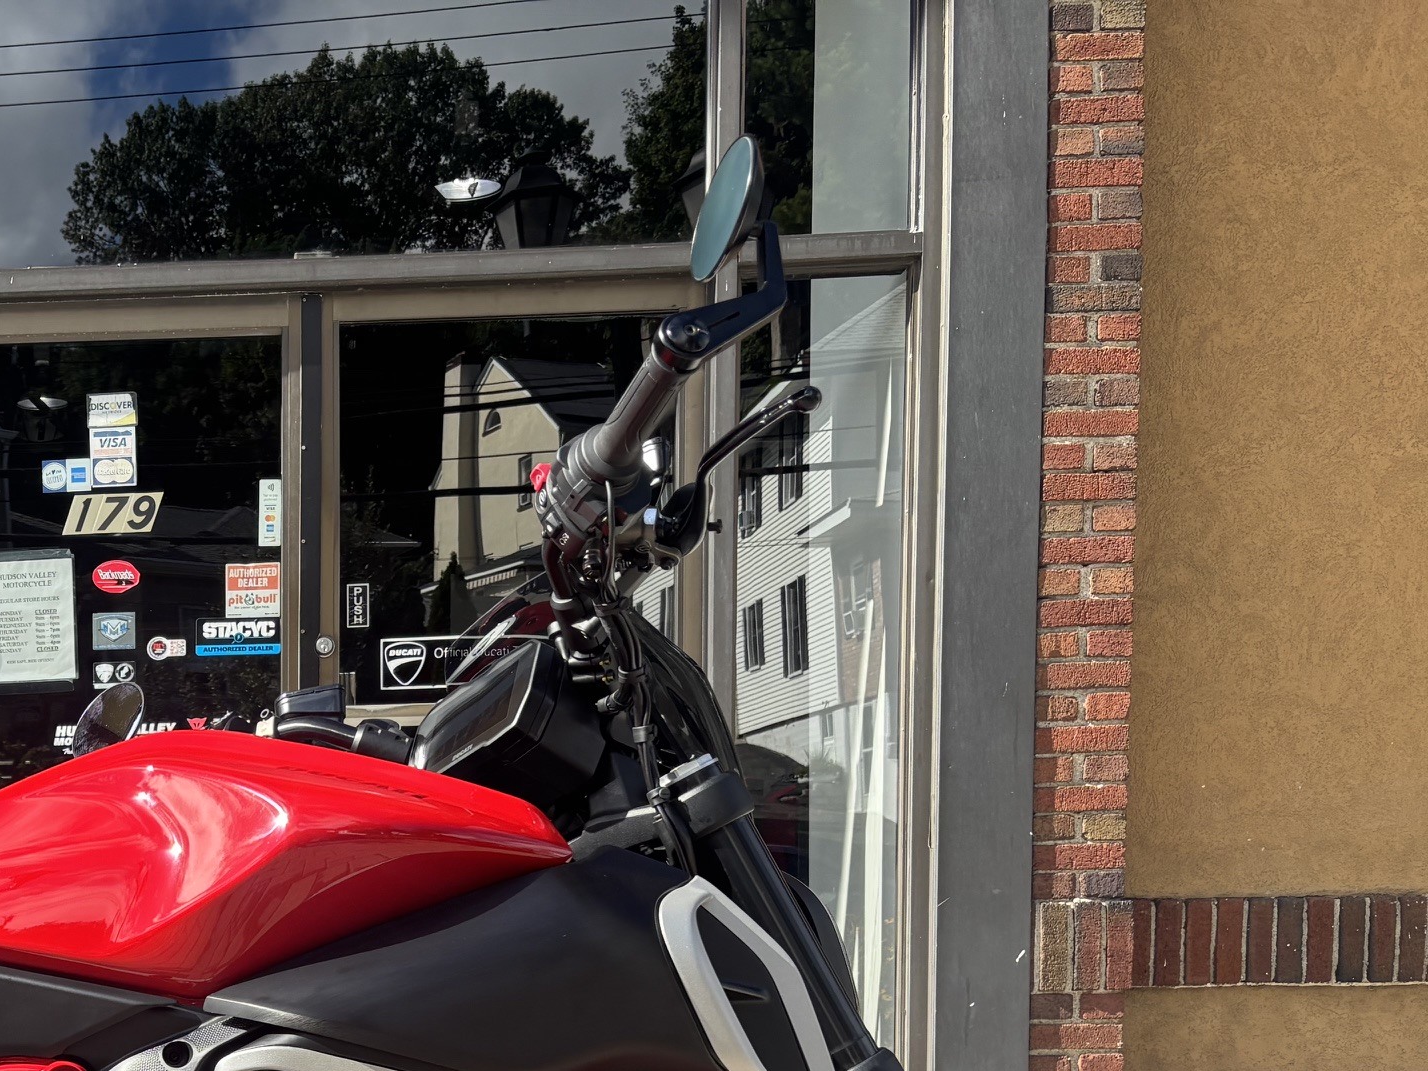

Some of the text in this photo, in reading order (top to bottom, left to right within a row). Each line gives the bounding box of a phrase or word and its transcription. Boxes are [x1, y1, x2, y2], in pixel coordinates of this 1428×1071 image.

[90, 400, 133, 411] DISCOVER
[99, 437, 127, 448] VISA
[74, 495, 157, 532] 179
[28, 571, 57, 579] VALLEY
[228, 567, 277, 578] AUTHORIZED
[2, 580, 53, 589] MOTORCYCLE
[237, 577, 269, 588] DEALER
[228, 593, 277, 607] pit bull
[353, 586, 363, 625] PUSH
[34, 608, 58, 616] CLOSED
[202, 620, 276, 640] STACYC
[36, 645, 59, 653] CLOSED
[388, 648, 422, 657] DUCATI
[137, 722, 177, 735] ALLEY
